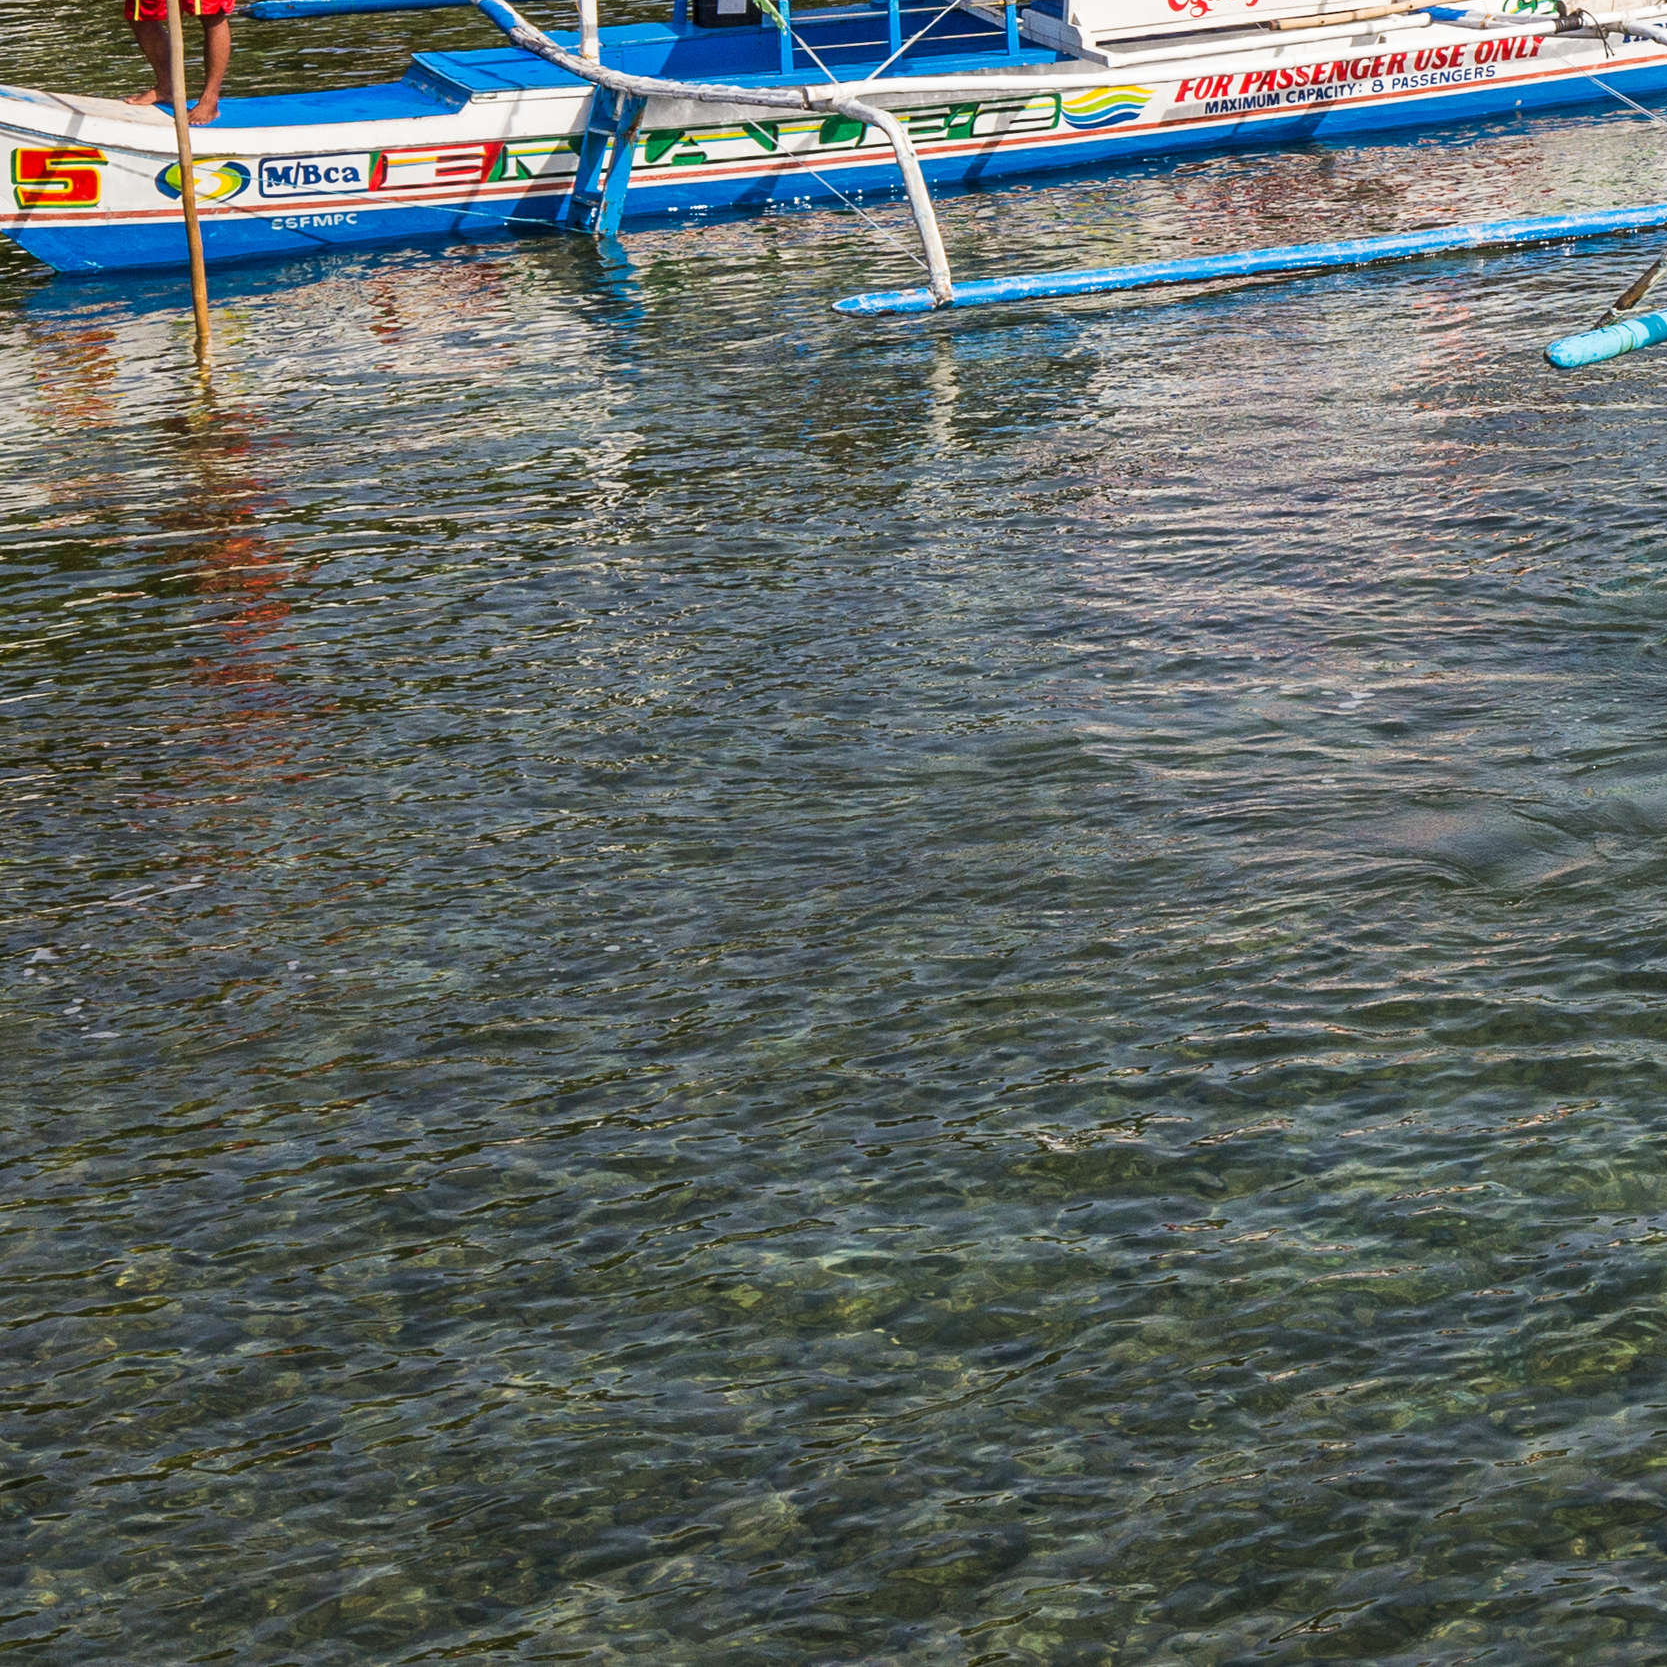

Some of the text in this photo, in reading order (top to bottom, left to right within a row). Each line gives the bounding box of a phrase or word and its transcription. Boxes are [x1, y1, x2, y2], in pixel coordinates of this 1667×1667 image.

[1175, 34, 1547, 103] FOR PASSENGER USE ONLY
[1203, 91, 1281, 115] MAXIMUM
[1371, 78, 1384, 94] 8
[1390, 64, 1497, 92] PASSENGERS
[11, 146, 108, 210] 5
[263, 158, 362, 191] M/Bca
